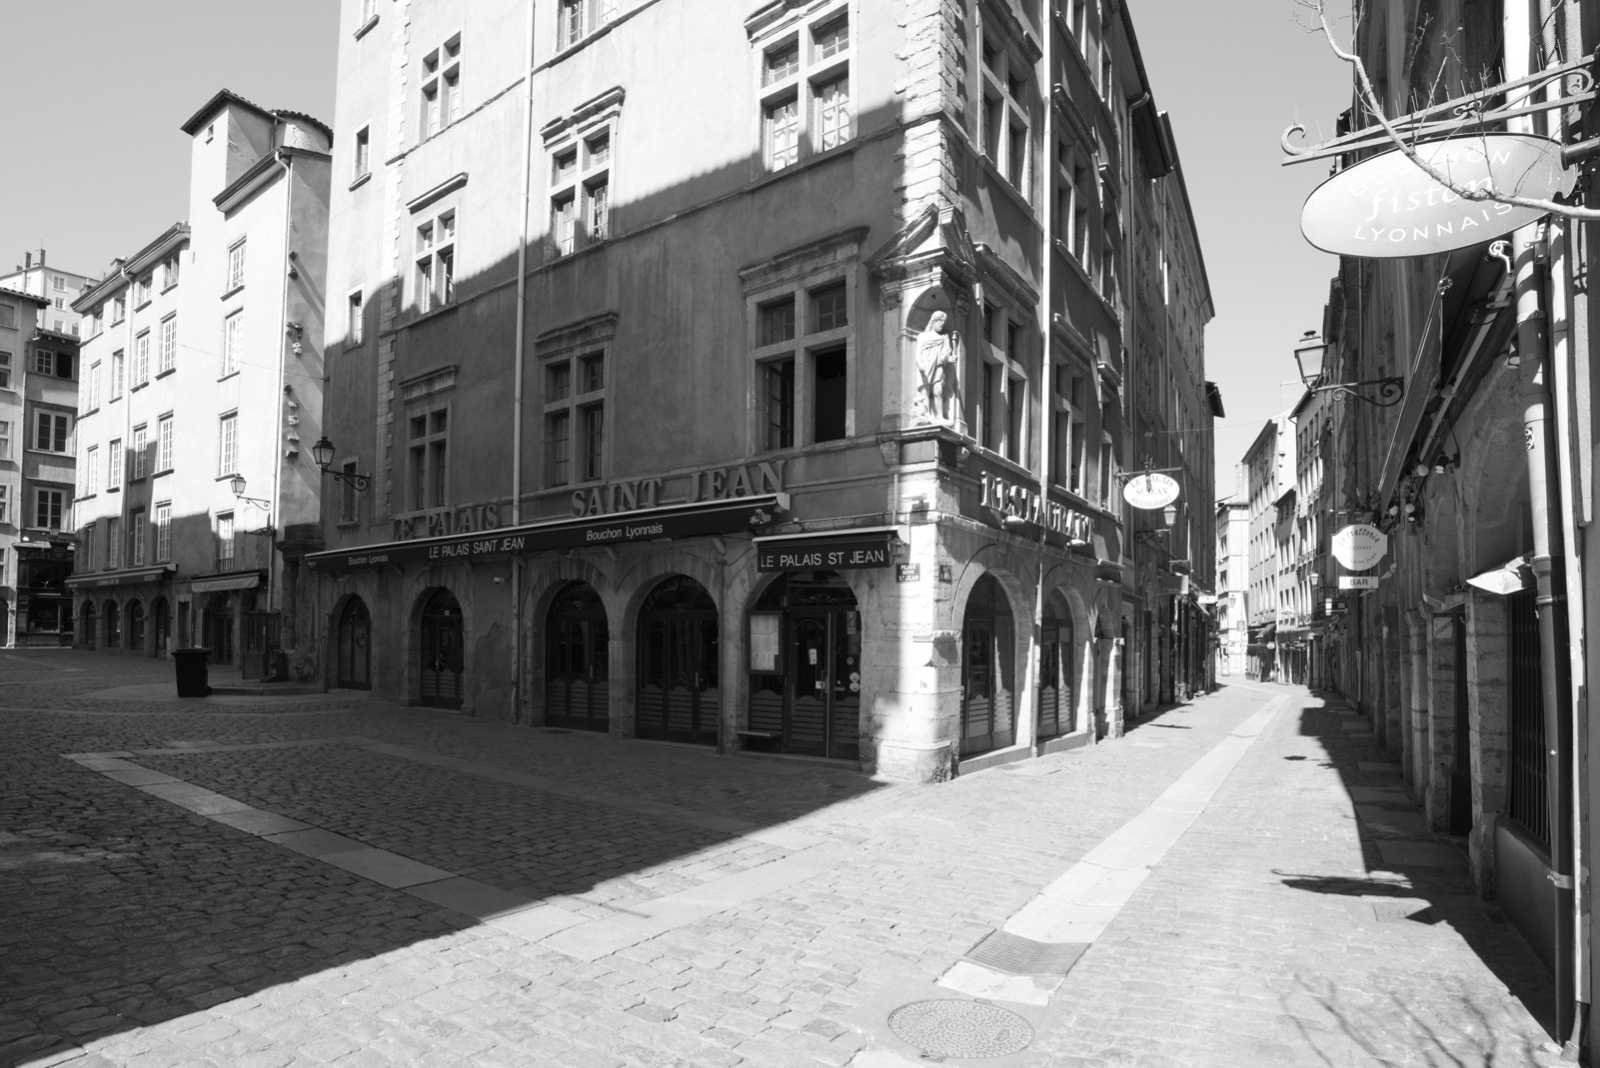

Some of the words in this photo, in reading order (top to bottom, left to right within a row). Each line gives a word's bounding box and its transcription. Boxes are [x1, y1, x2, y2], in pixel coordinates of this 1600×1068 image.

[1350, 150, 1511, 198] BOUHON
[1353, 202, 1514, 242] LYONNAIS
[569, 476, 663, 519] SAINT
[685, 459, 786, 504] JEAN
[980, 470, 1095, 545] RESTAURANT
[389, 518, 413, 542] LE
[424, 504, 501, 538] PALAIS
[586, 527, 622, 542] Bouchon
[626, 522, 664, 540] Lyonnais
[348, 556, 368, 566] Bouchon
[368, 553, 389, 565] Lyonnais
[429, 546, 439, 559] LE
[442, 543, 470, 558] PALAIS
[472, 539, 499, 555] SAINT
[500, 536, 525, 552] JEAN
[760, 555, 775, 568] LE
[779, 552, 822, 567] PALAIS
[828, 551, 845, 565] ST
[849, 549, 885, 564] JEAN
